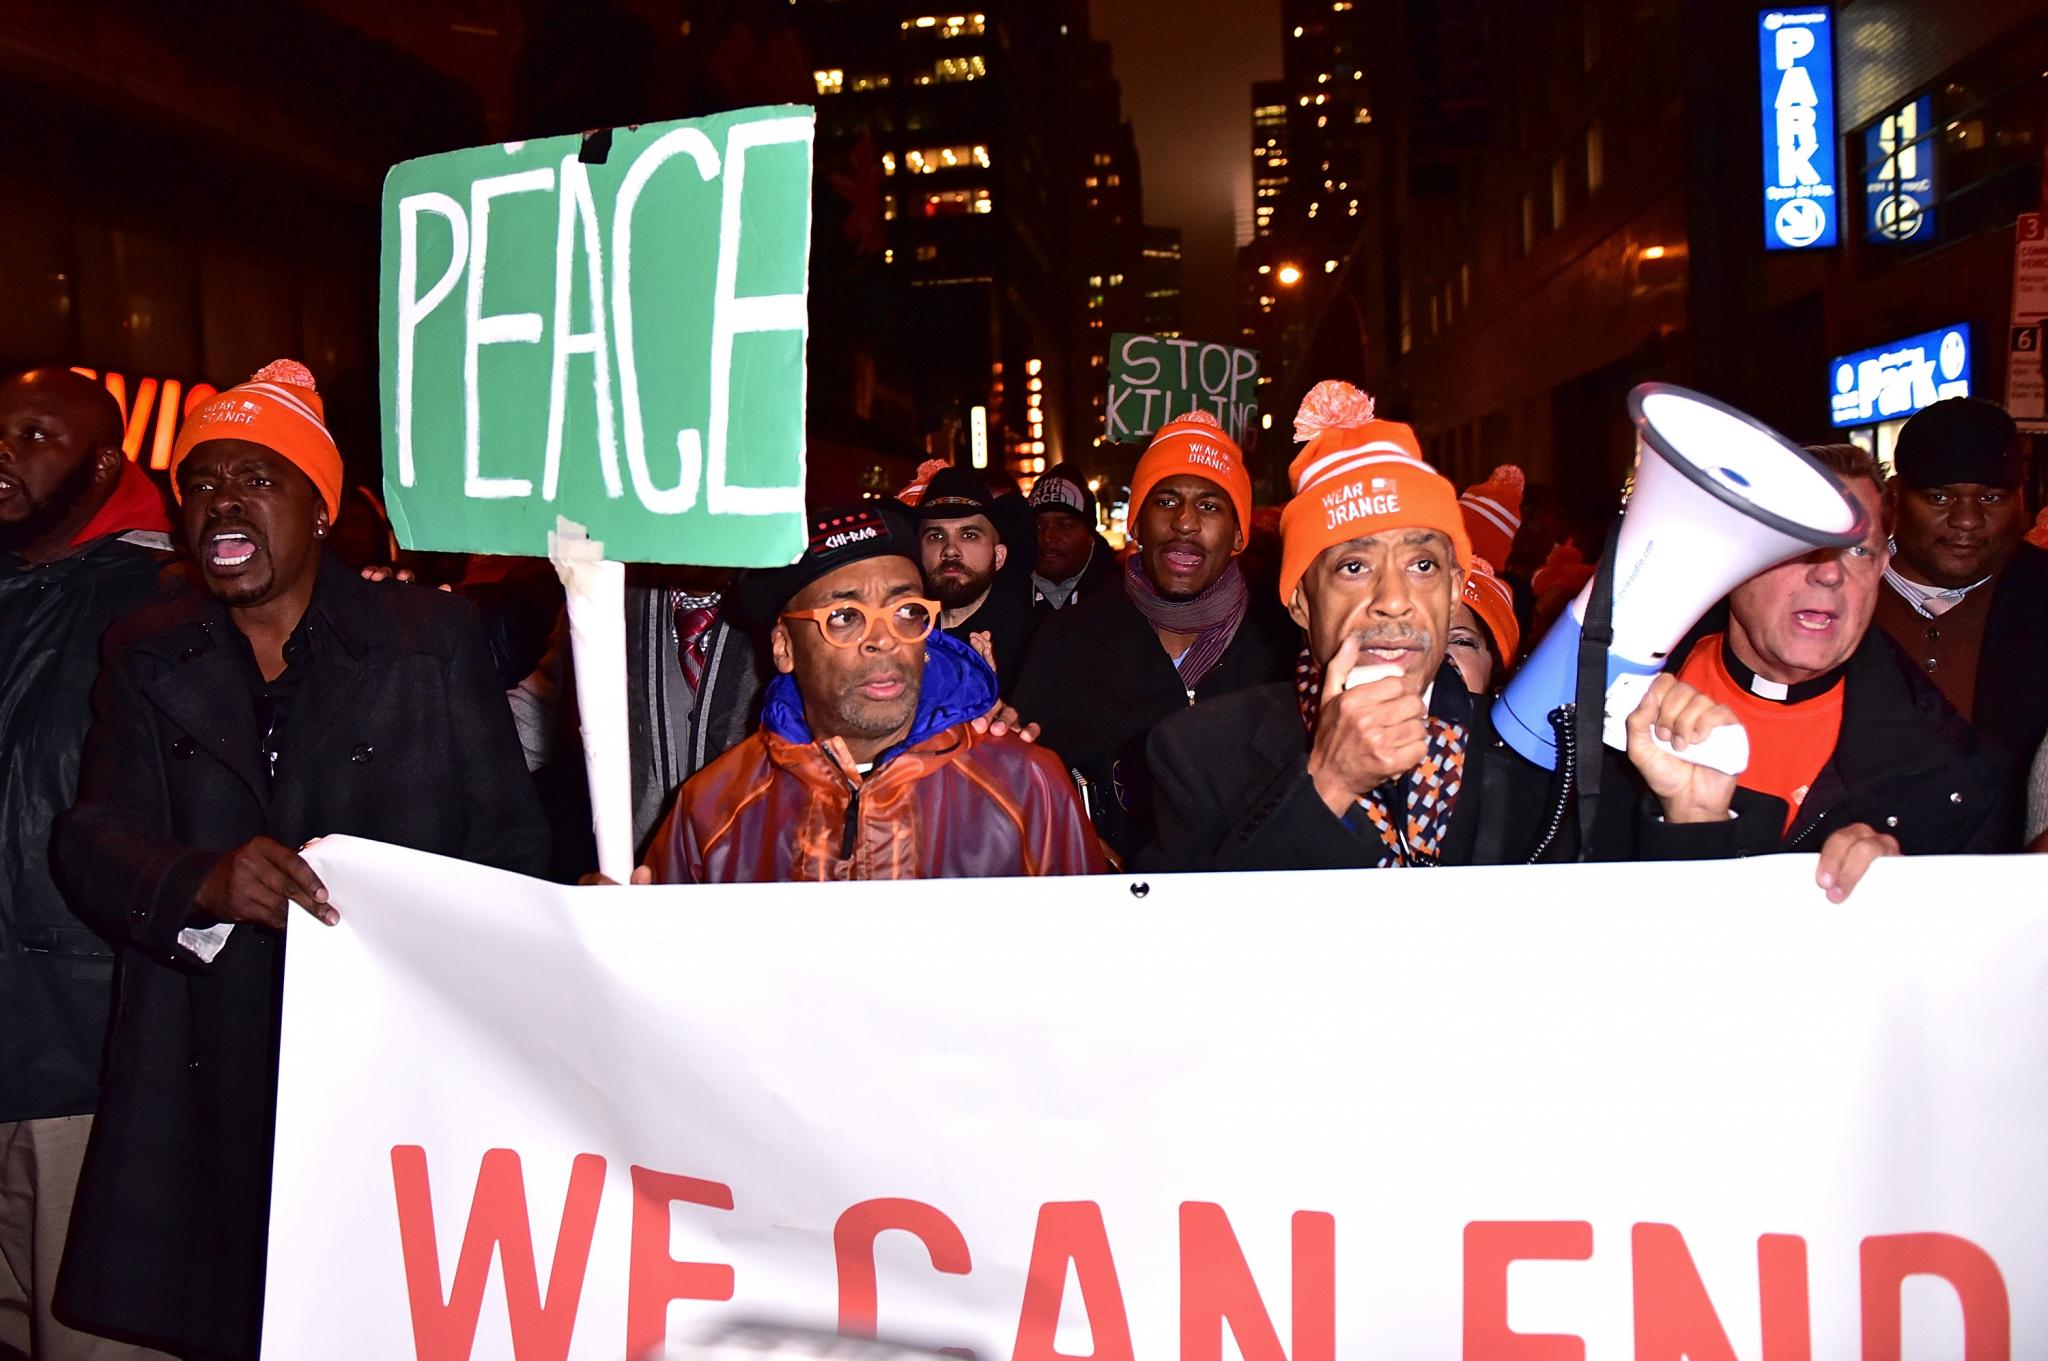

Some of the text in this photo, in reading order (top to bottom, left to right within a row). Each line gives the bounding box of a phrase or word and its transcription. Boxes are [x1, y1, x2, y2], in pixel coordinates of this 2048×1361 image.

[1774, 27, 1821, 187] PARK
[2024, 218, 2039, 239] 3
[396, 115, 815, 515] PEACE
[2017, 329, 2032, 350] 6
[1120, 335, 1257, 401] STOP
[203, 399, 236, 412] WAR
[1322, 482, 1364, 507] WEAR
[390, 1144, 735, 1361] WE
[833, 1196, 1336, 1361] CAN
